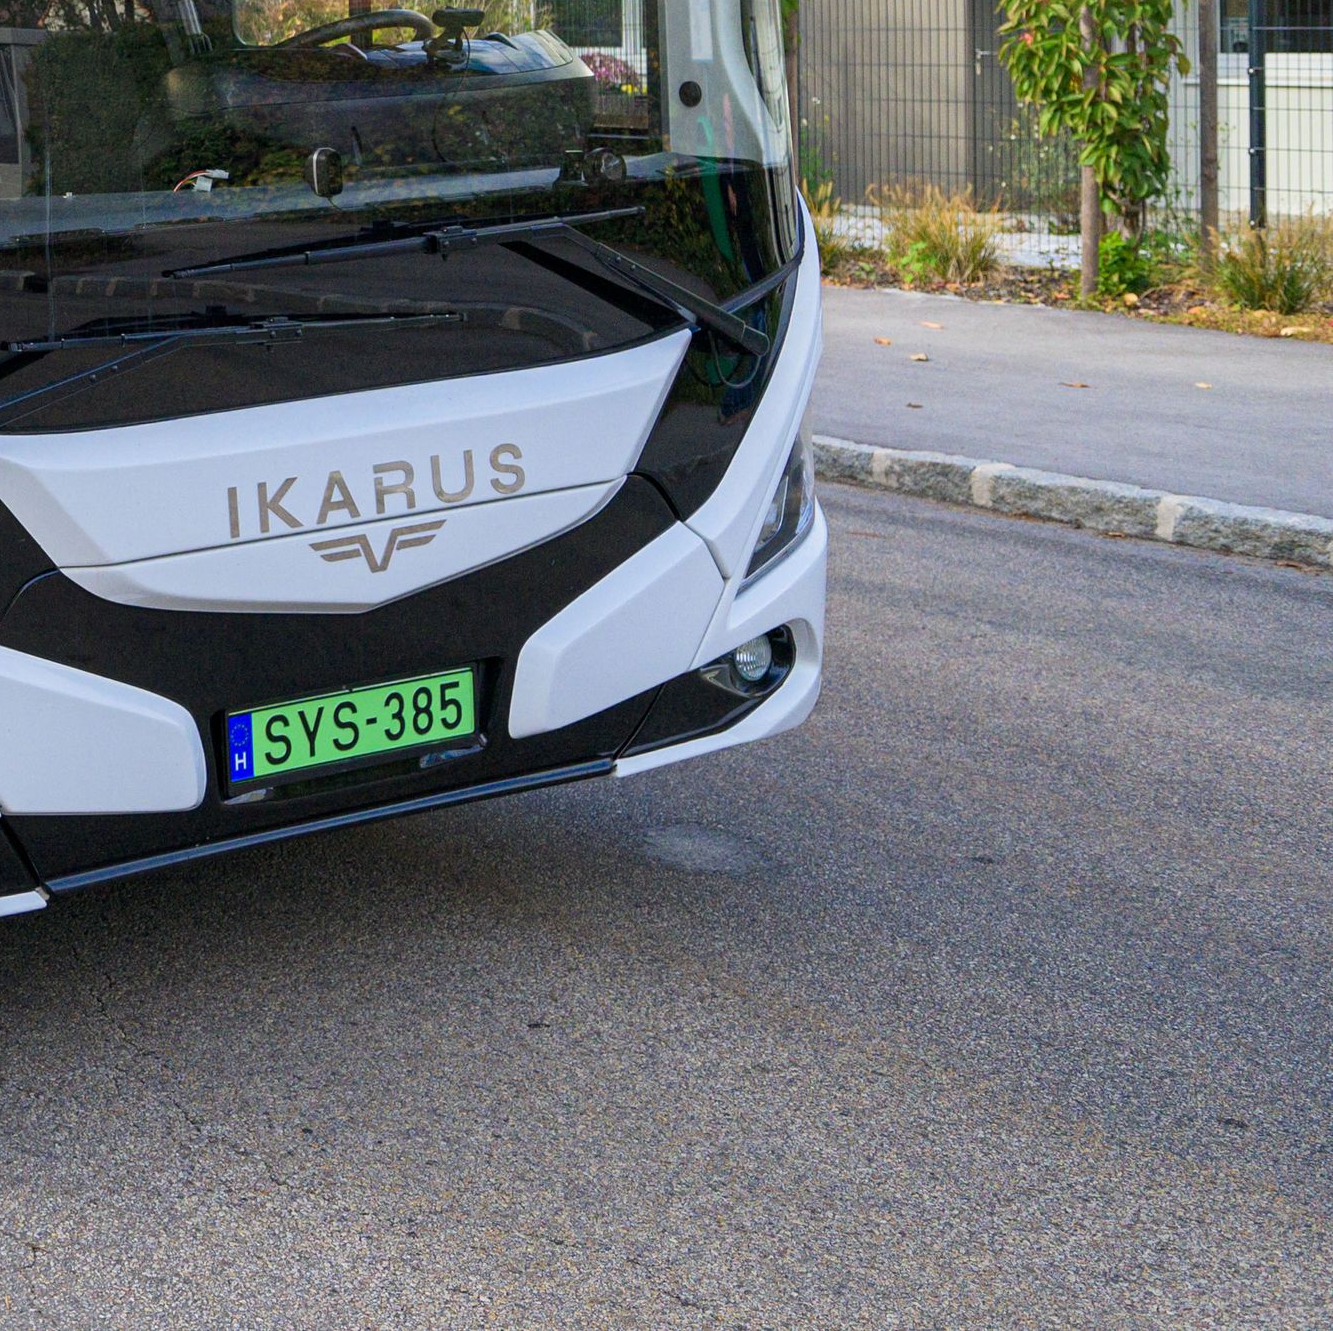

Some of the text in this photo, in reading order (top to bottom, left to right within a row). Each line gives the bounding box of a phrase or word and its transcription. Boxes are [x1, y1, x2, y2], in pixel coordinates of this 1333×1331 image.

[227, 442, 526, 540] IKARUS
[234, 751, 247, 772] H
[264, 681, 463, 766] SYS-385
